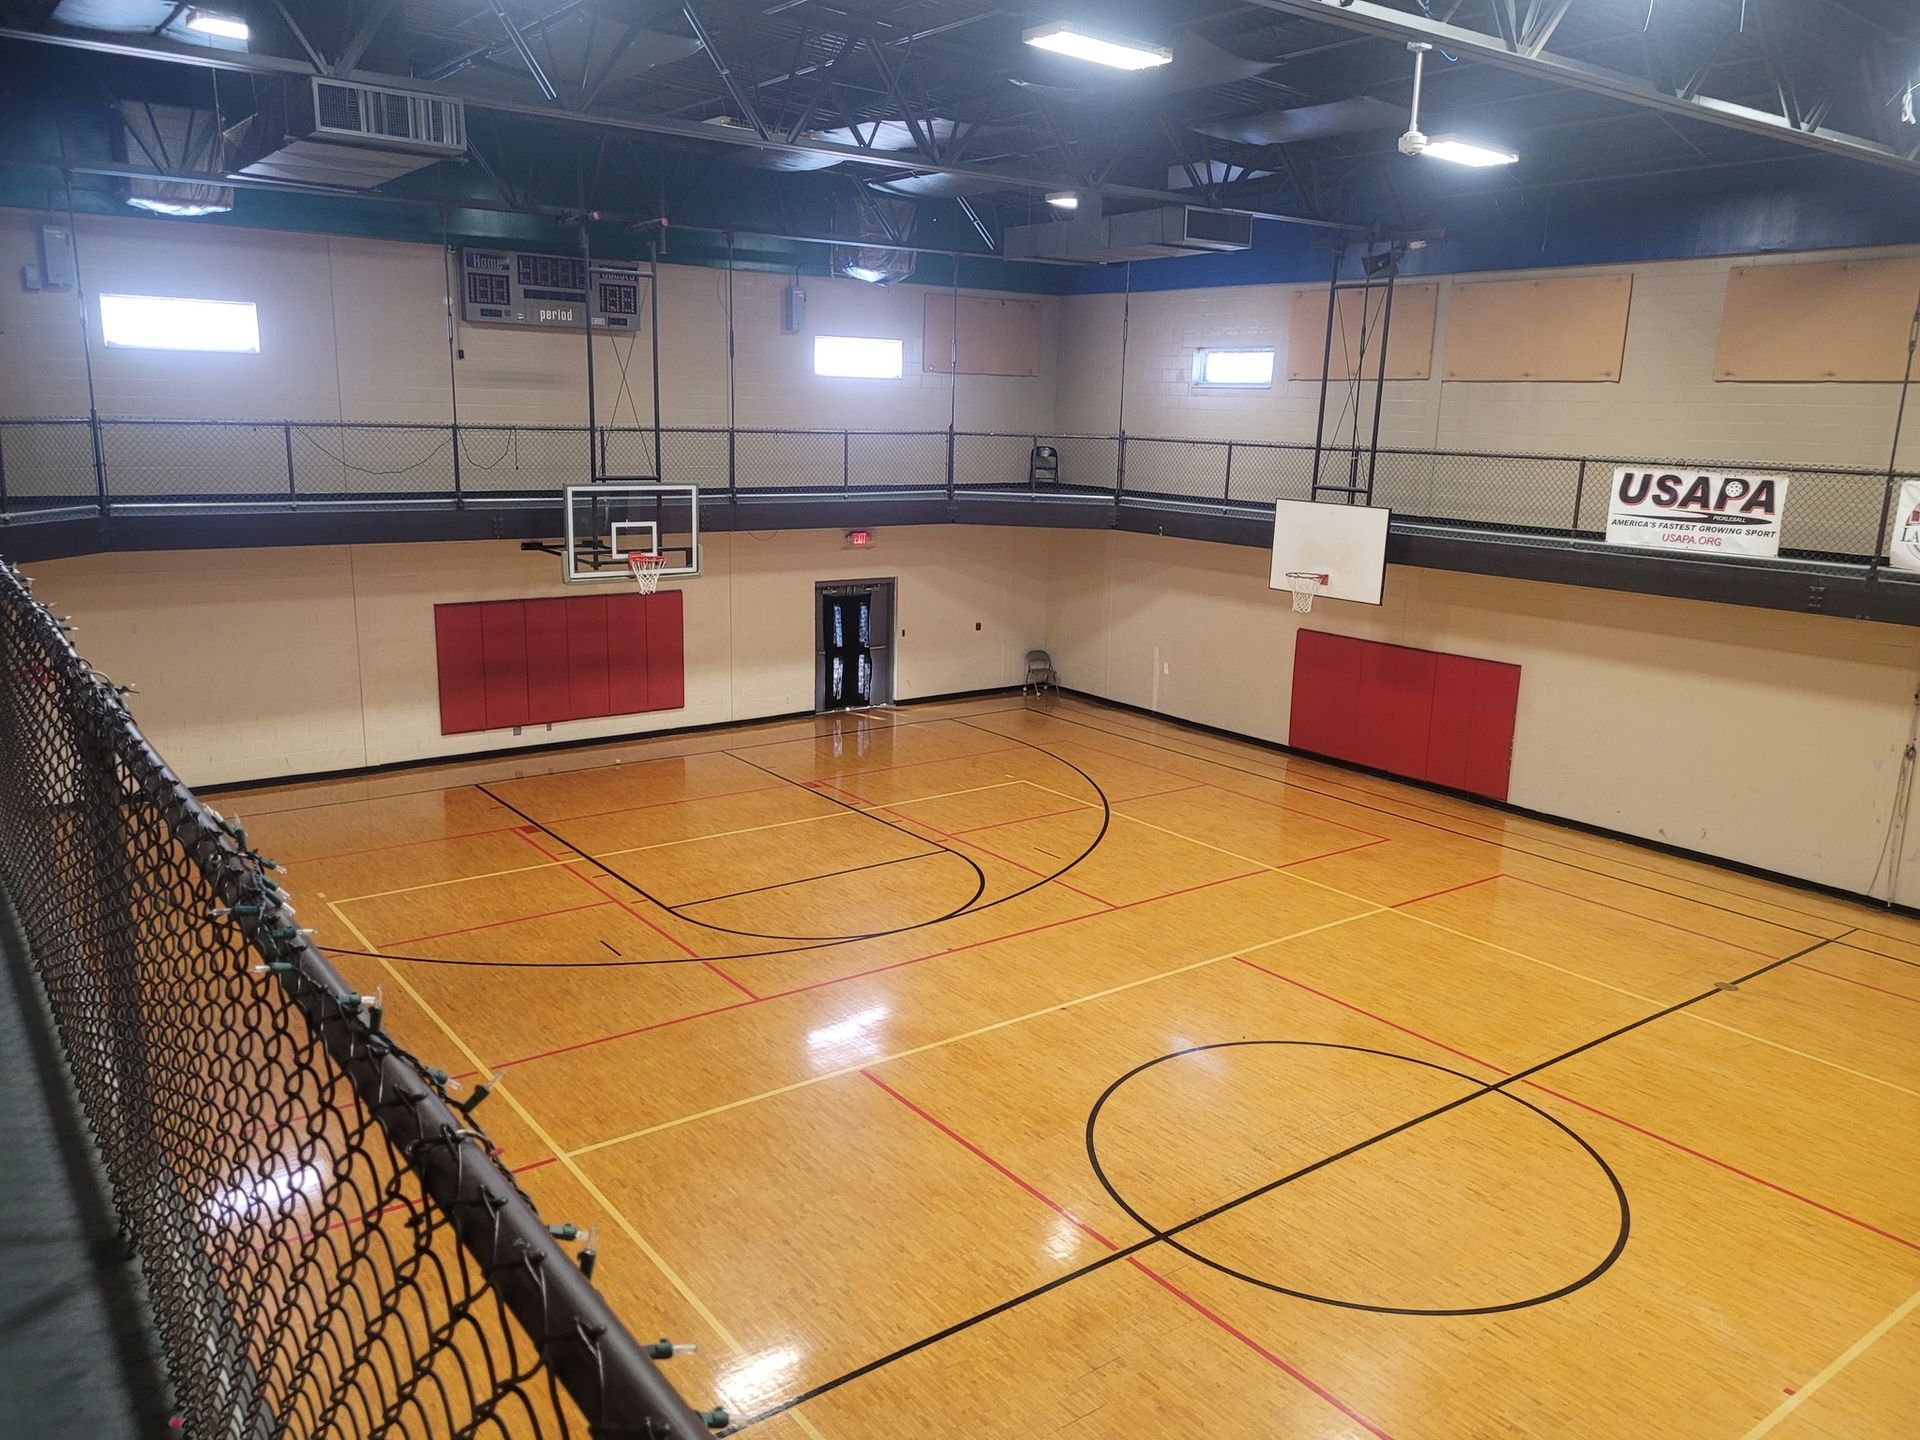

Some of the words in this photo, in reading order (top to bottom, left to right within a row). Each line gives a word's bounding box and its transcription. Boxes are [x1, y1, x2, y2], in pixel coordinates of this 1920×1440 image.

[539, 308, 573, 322] period
[1618, 472, 1776, 515] USAPA
[1712, 515, 1747, 523] PICKLEBALL
[1611, 519, 1656, 529] AMERICA'S
[1658, 522, 1696, 531] FASTEST
[1699, 525, 1742, 535] GROWING
[1745, 529, 1777, 538] SPORT
[1661, 533, 1723, 547] USAPA.ORG
